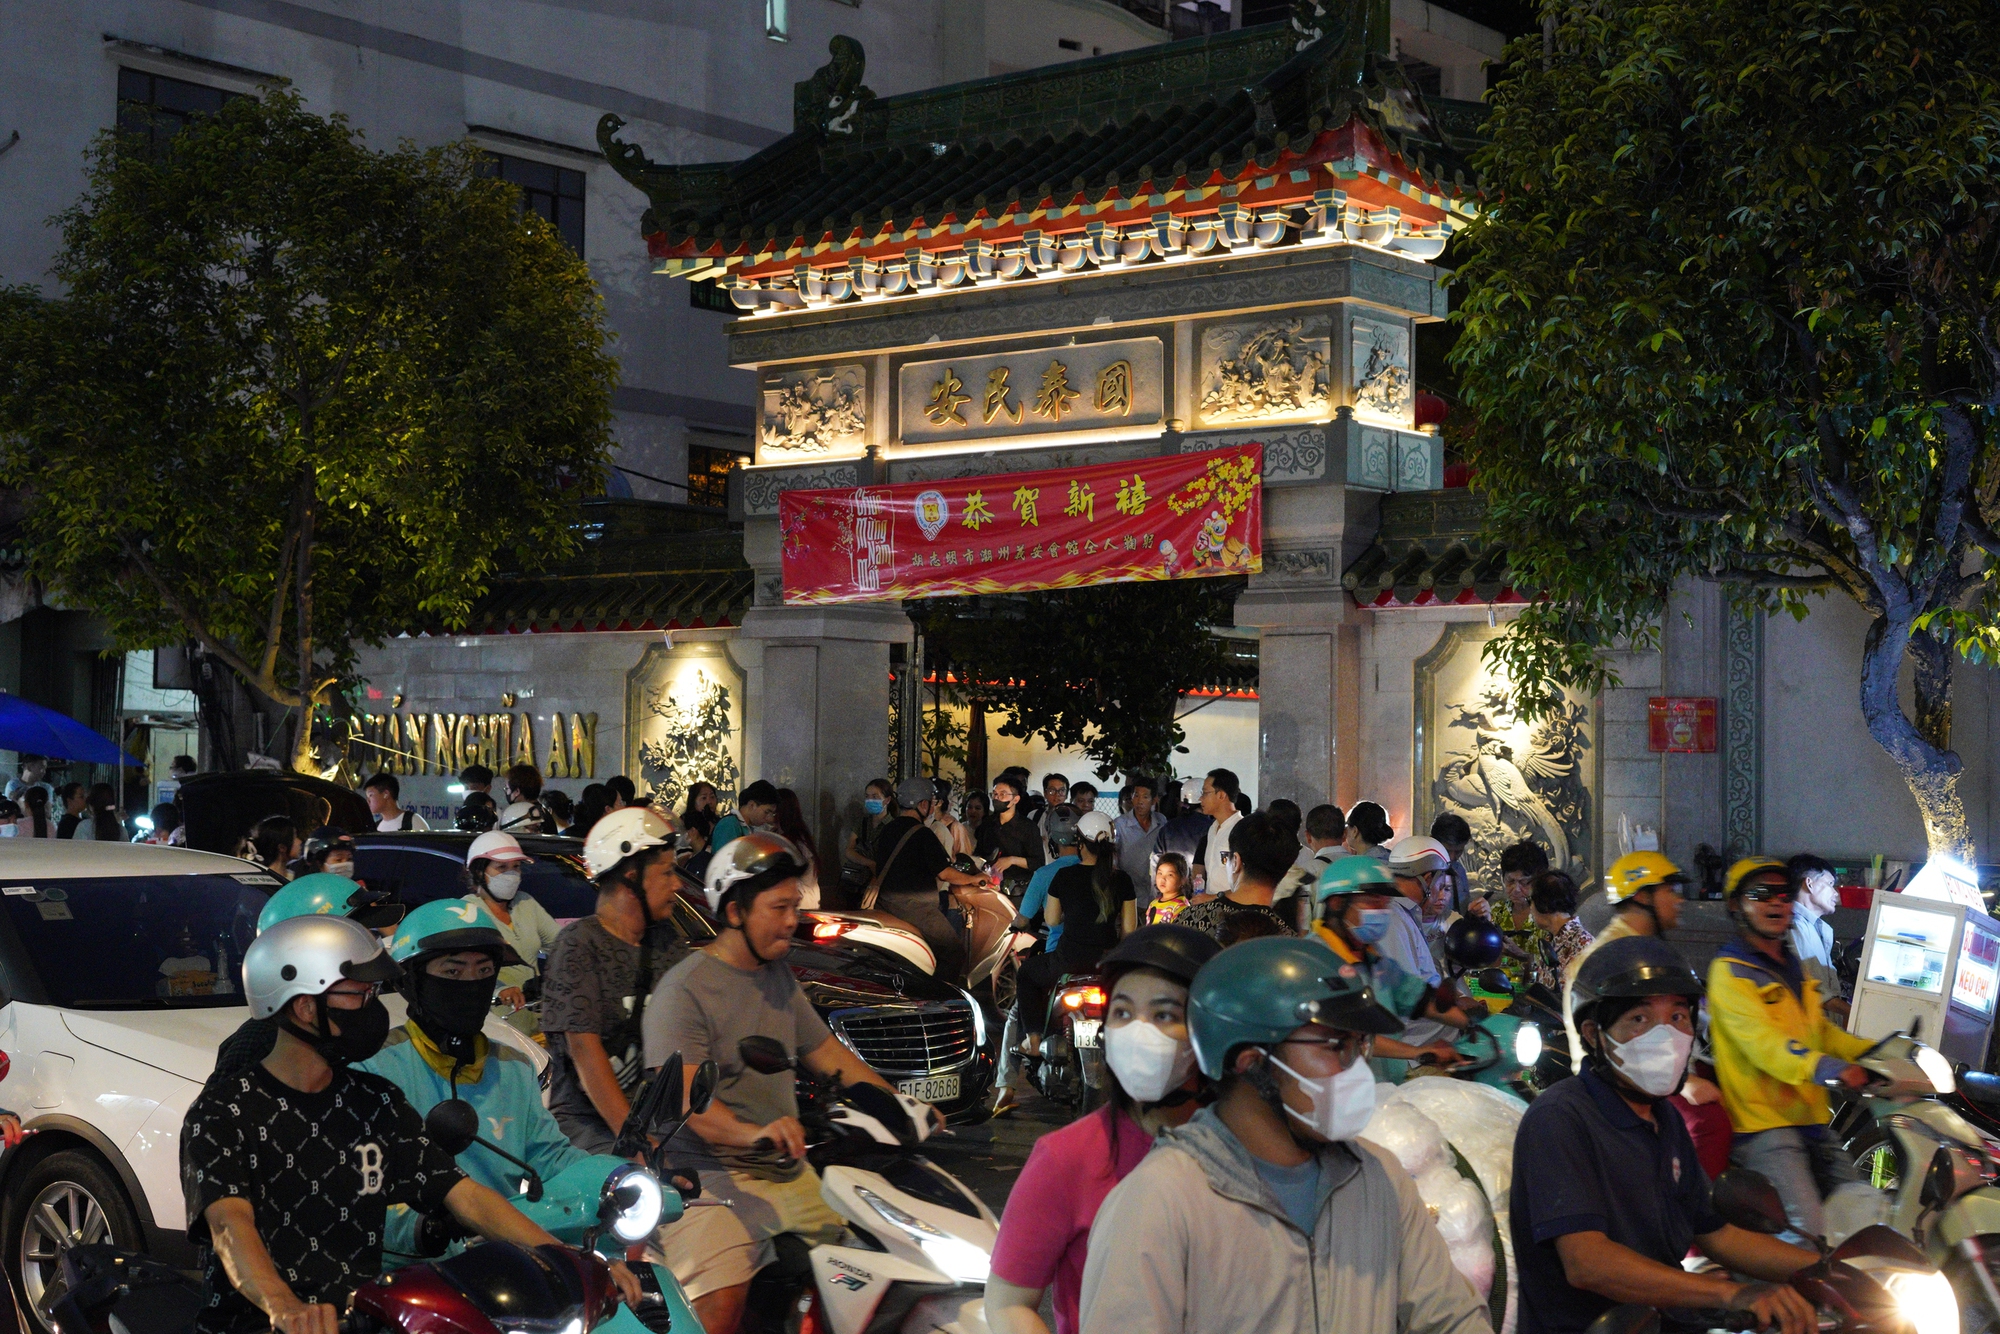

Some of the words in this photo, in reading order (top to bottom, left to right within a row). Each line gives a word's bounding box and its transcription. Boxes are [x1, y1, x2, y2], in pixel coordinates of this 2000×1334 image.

[962, 474, 1152, 531] 恭賀新禧
[856, 517, 888, 553] Mừng
[867, 541, 892, 567] Năm
[857, 558, 880, 592] Mới
[433, 693, 536, 777] NGHĨA
[544, 712, 598, 779] AN
[421, 806, 449, 820] TP.HCM
[355, 1143, 384, 1195] B
